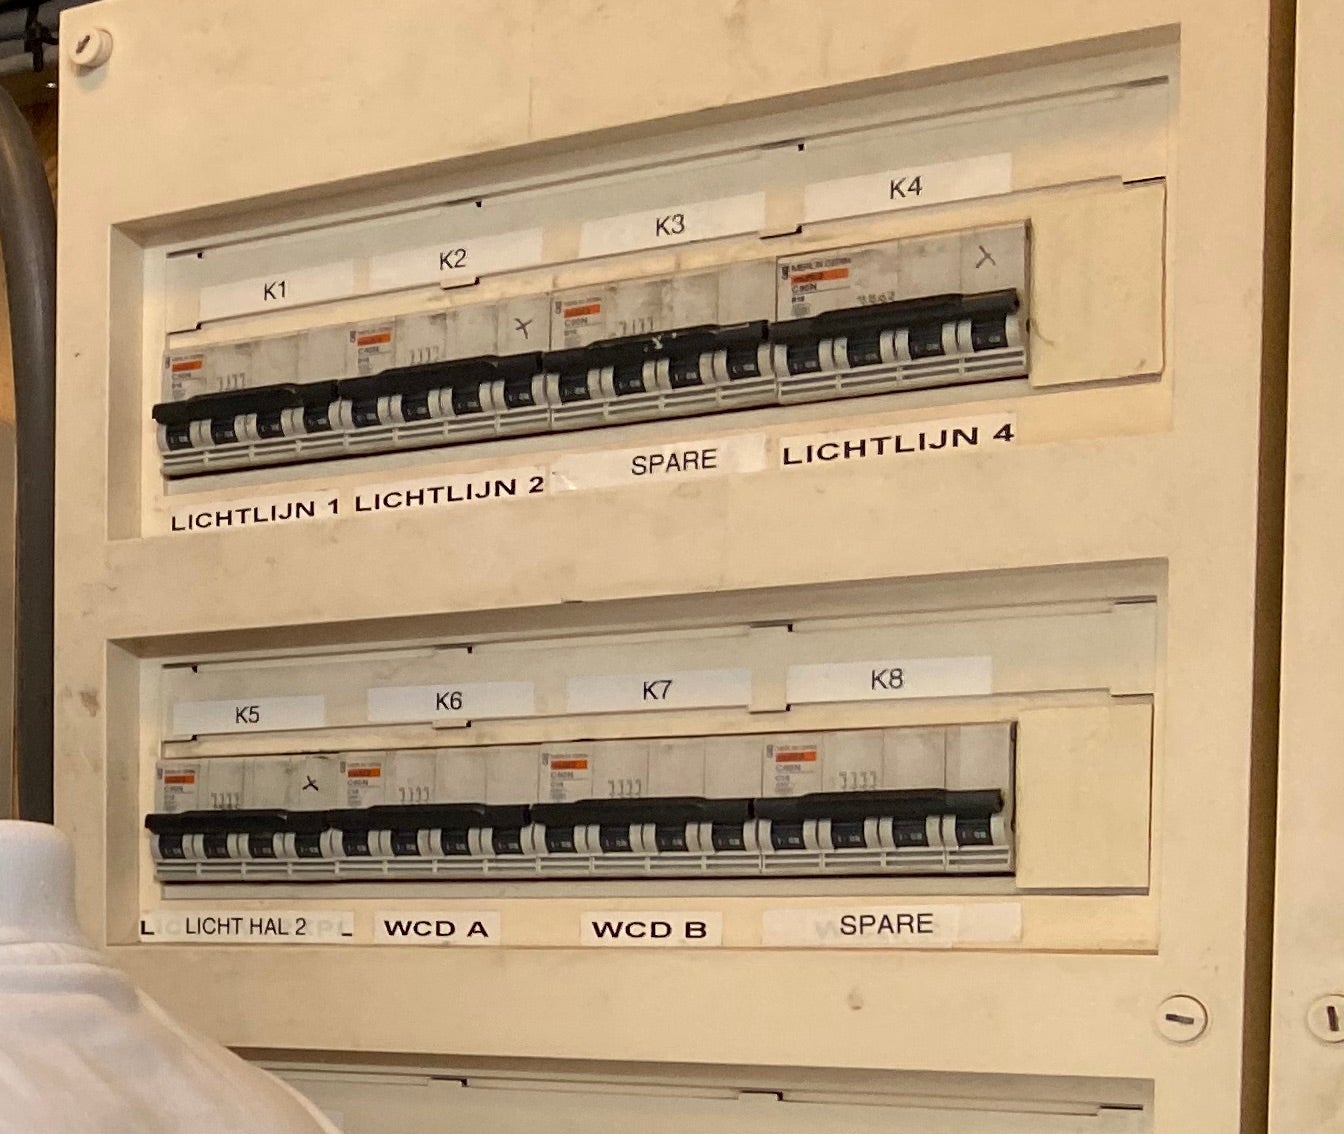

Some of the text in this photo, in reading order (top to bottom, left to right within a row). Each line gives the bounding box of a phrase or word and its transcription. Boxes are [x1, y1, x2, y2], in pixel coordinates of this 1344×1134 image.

[889, 175, 923, 199] K4
[655, 213, 686, 237] K3
[439, 248, 467, 271] K2
[263, 280, 287, 301] K1
[783, 423, 1016, 466] LICHTLIJN 4
[630, 448, 718, 476] SPARE
[354, 475, 545, 513] LICHTLIJN 2
[170, 498, 341, 532] LICHTLIJN 1
[643, 679, 673, 701] K7
[871, 667, 904, 691] K8
[436, 691, 463, 711] K6
[235, 705, 260, 724] K5
[185, 917, 307, 936] LICHT HAL 2
[383, 920, 489, 938] WCD A
[592, 921, 707, 939] WCD B
[840, 913, 934, 936] SPARE
